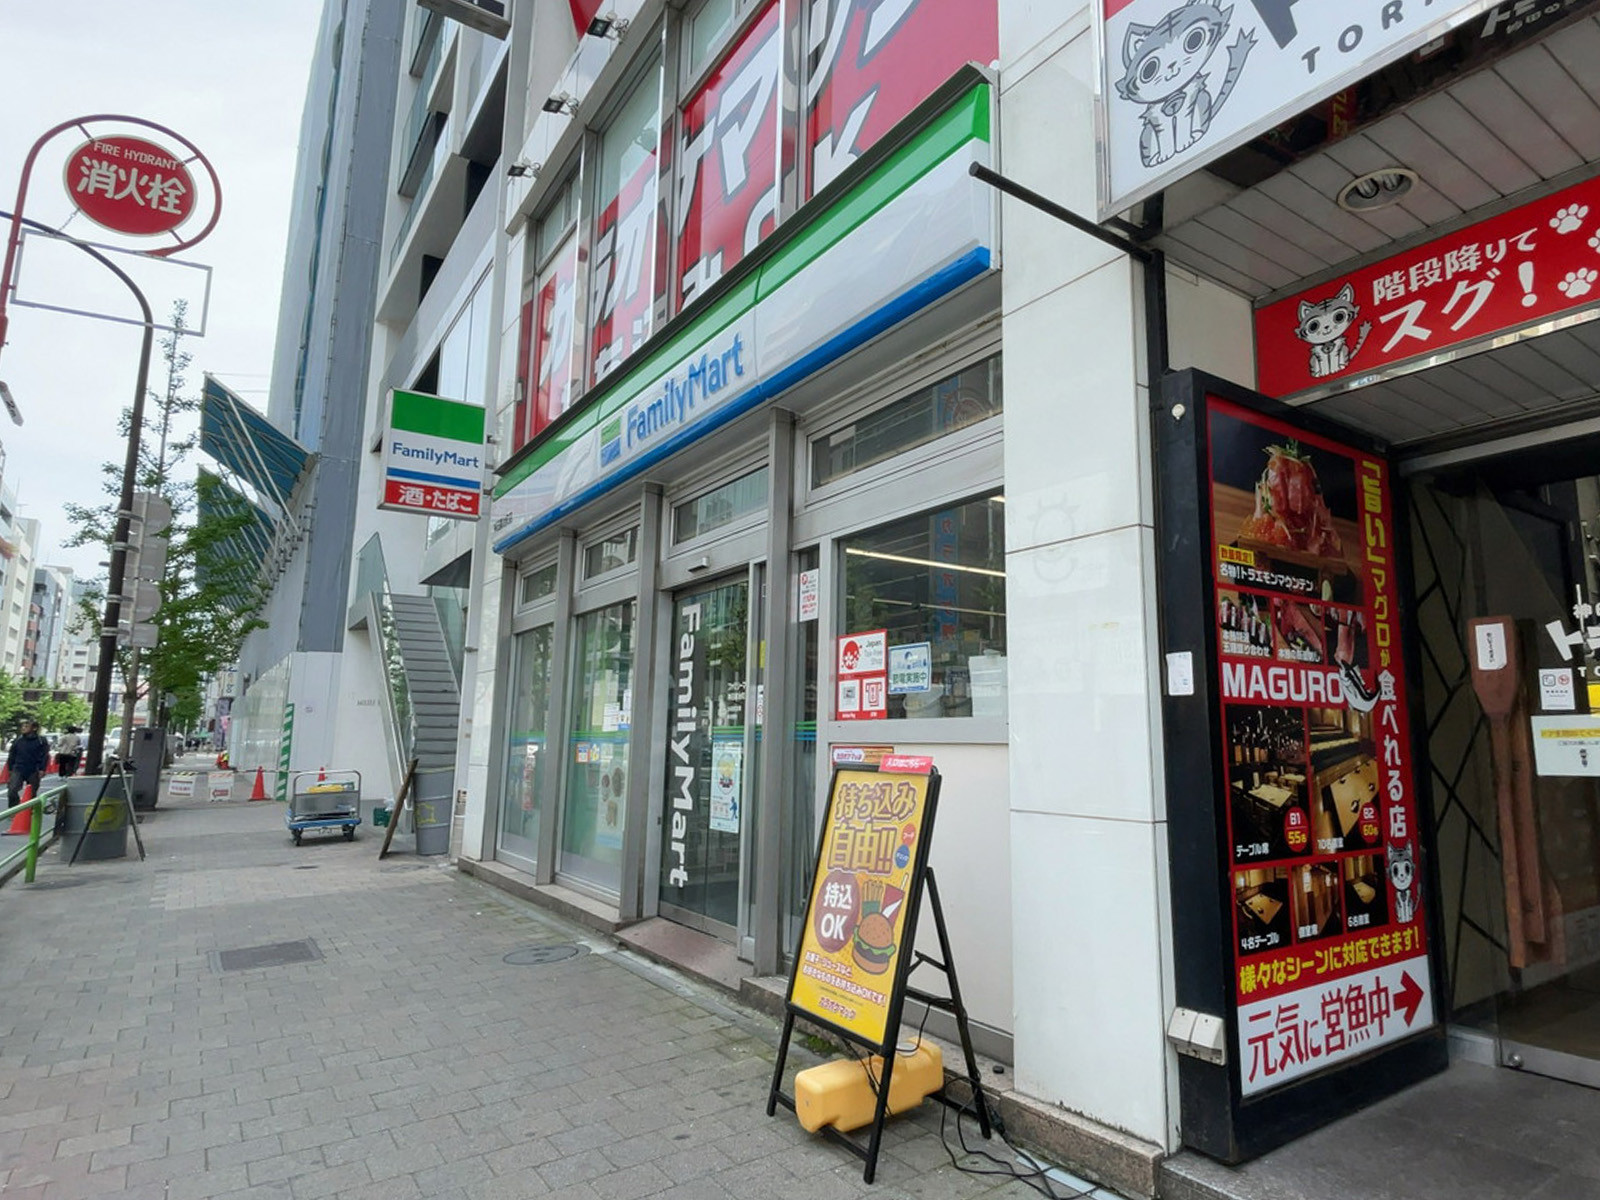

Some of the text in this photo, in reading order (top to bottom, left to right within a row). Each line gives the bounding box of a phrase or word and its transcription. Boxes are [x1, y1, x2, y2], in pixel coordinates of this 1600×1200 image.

[1302, 0, 1441, 73] TOR
[93, 141, 178, 170] FIRE HYDRANT
[77, 156, 186, 215] 消火栓
[1372, 228, 1538, 306] 階段降りて
[627, 333, 744, 448] FamilyMart
[392, 442, 479, 468] FamilyMart
[1222, 662, 1345, 703] MAGURO
[669, 603, 700, 888] FamilyMart
[835, 782, 917, 821] 持ち込み
[823, 882, 852, 910] 持込
[821, 913, 848, 941] OK
[1247, 976, 1391, 1083] 元気に営魚中
